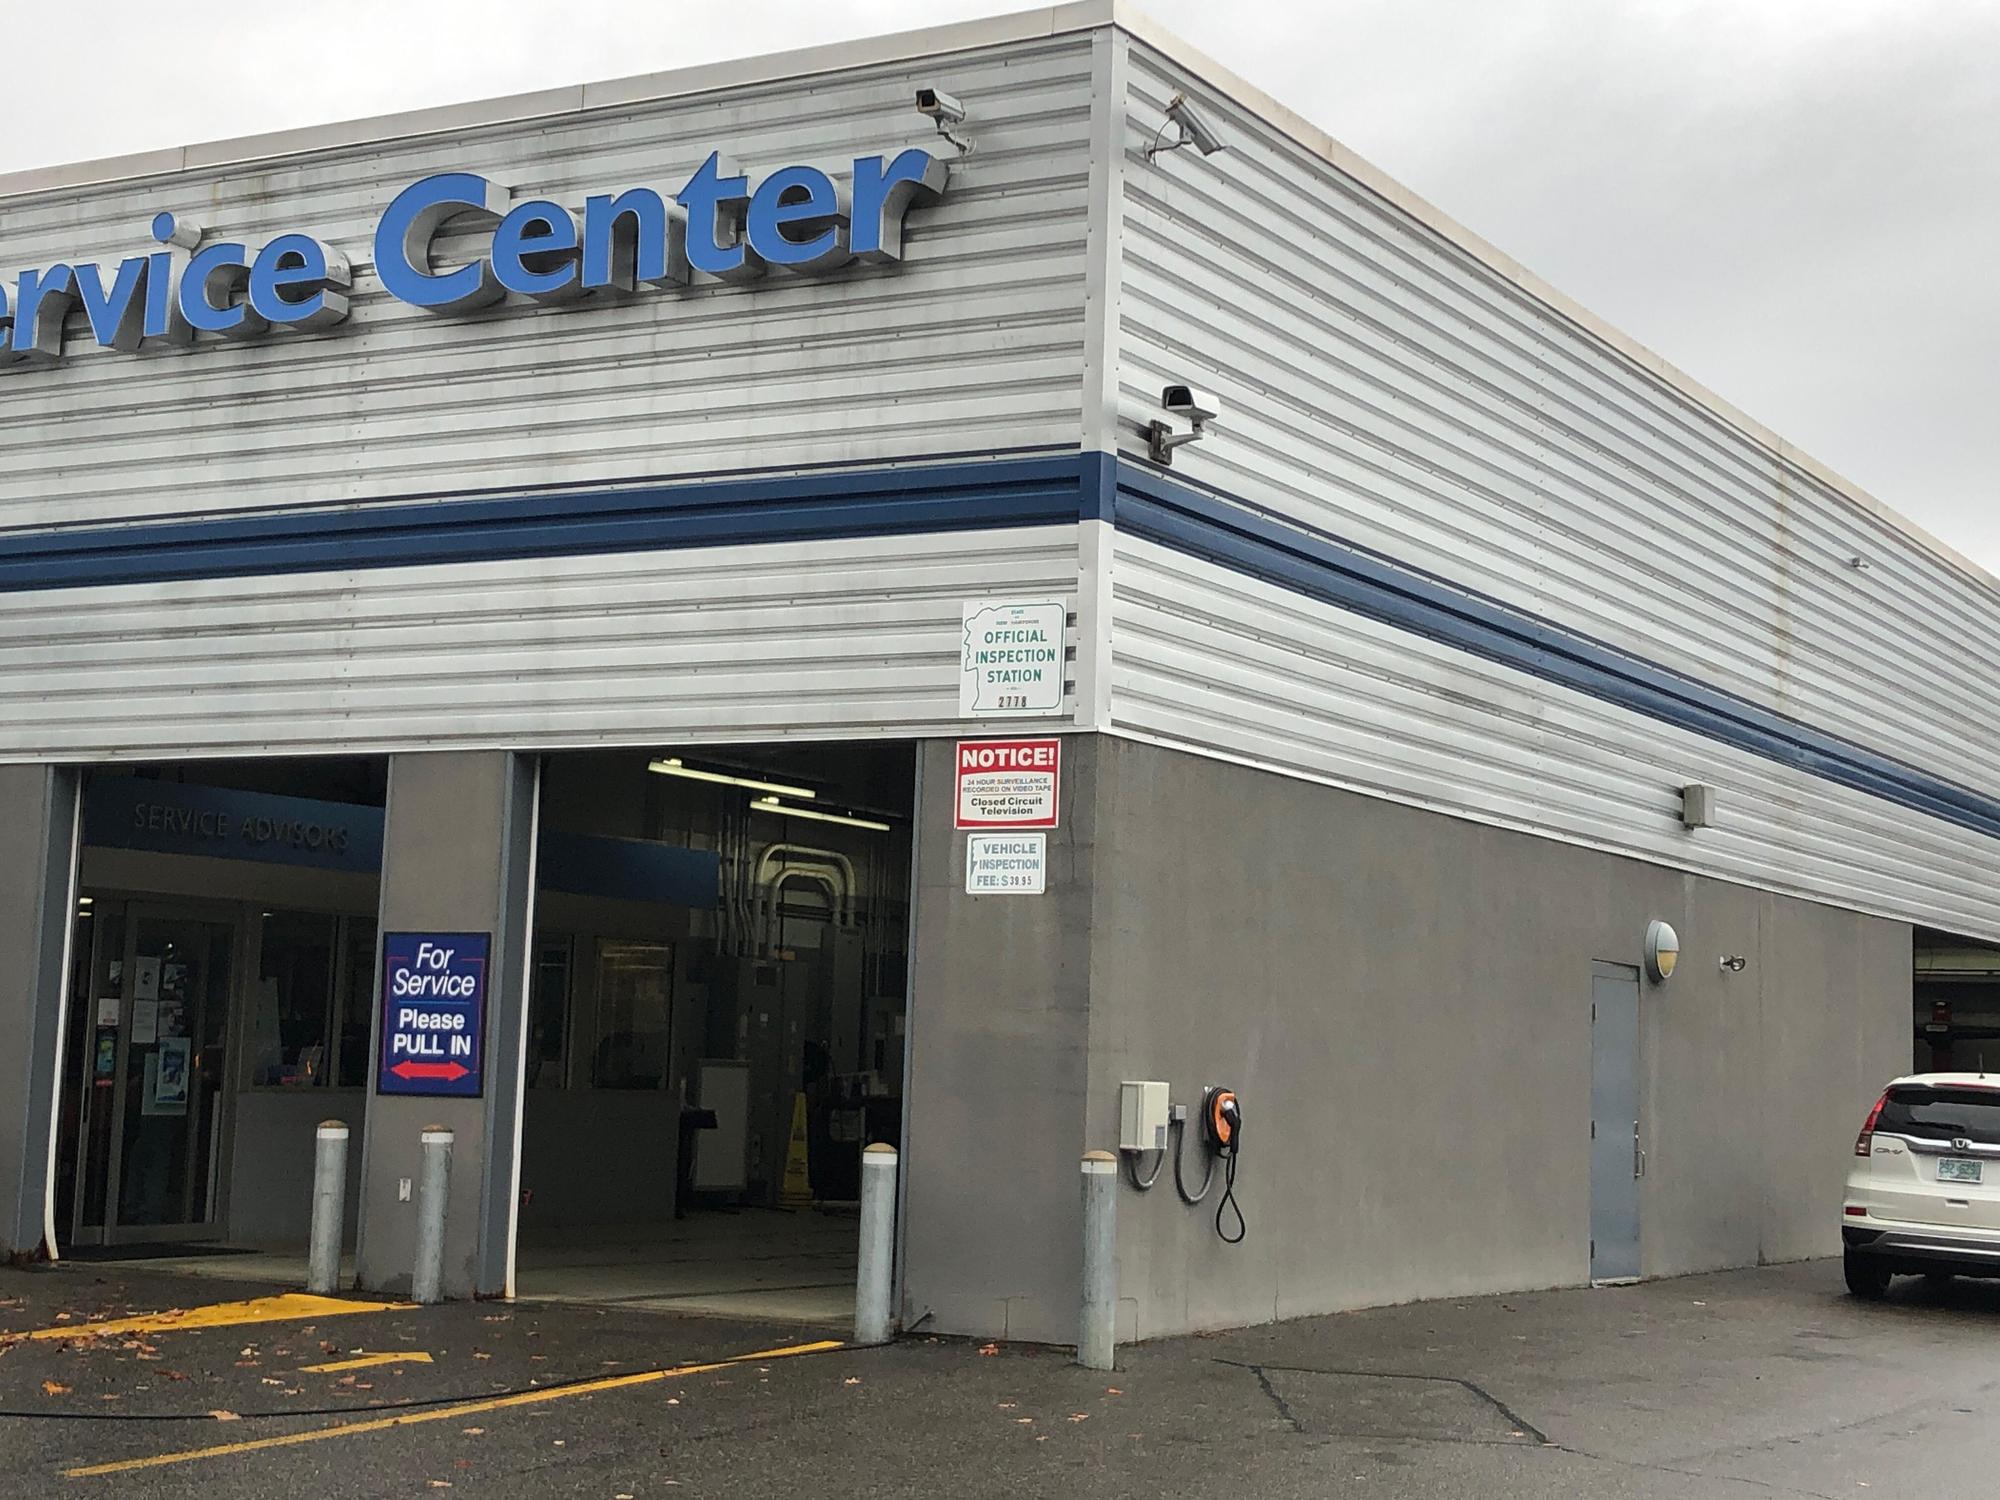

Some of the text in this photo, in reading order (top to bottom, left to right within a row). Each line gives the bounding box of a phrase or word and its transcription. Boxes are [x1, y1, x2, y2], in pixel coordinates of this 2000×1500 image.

[0, 148, 934, 350] rvice Center
[984, 629, 1048, 644] OFFICIAL
[975, 648, 1056, 664] INSPECTION
[987, 669, 1042, 683] STATION
[998, 696, 1027, 708] 2778
[962, 747, 1055, 767] NOTICE!
[997, 777, 1048, 785] SURVEILLANCE
[1035, 784, 1052, 792] TAPE
[971, 796, 1043, 806] Closed Circuit
[980, 806, 1033, 815] Television
[135, 803, 350, 850] SERVICE ADVISORS
[983, 843, 1037, 854] VEHICLE
[979, 859, 1040, 870] INSPECTION
[976, 875, 999, 886] FEE:
[416, 942, 454, 969] For
[393, 968, 475, 996] Service
[399, 1008, 465, 1029] Please
[393, 1033, 471, 1056] PULL IN
